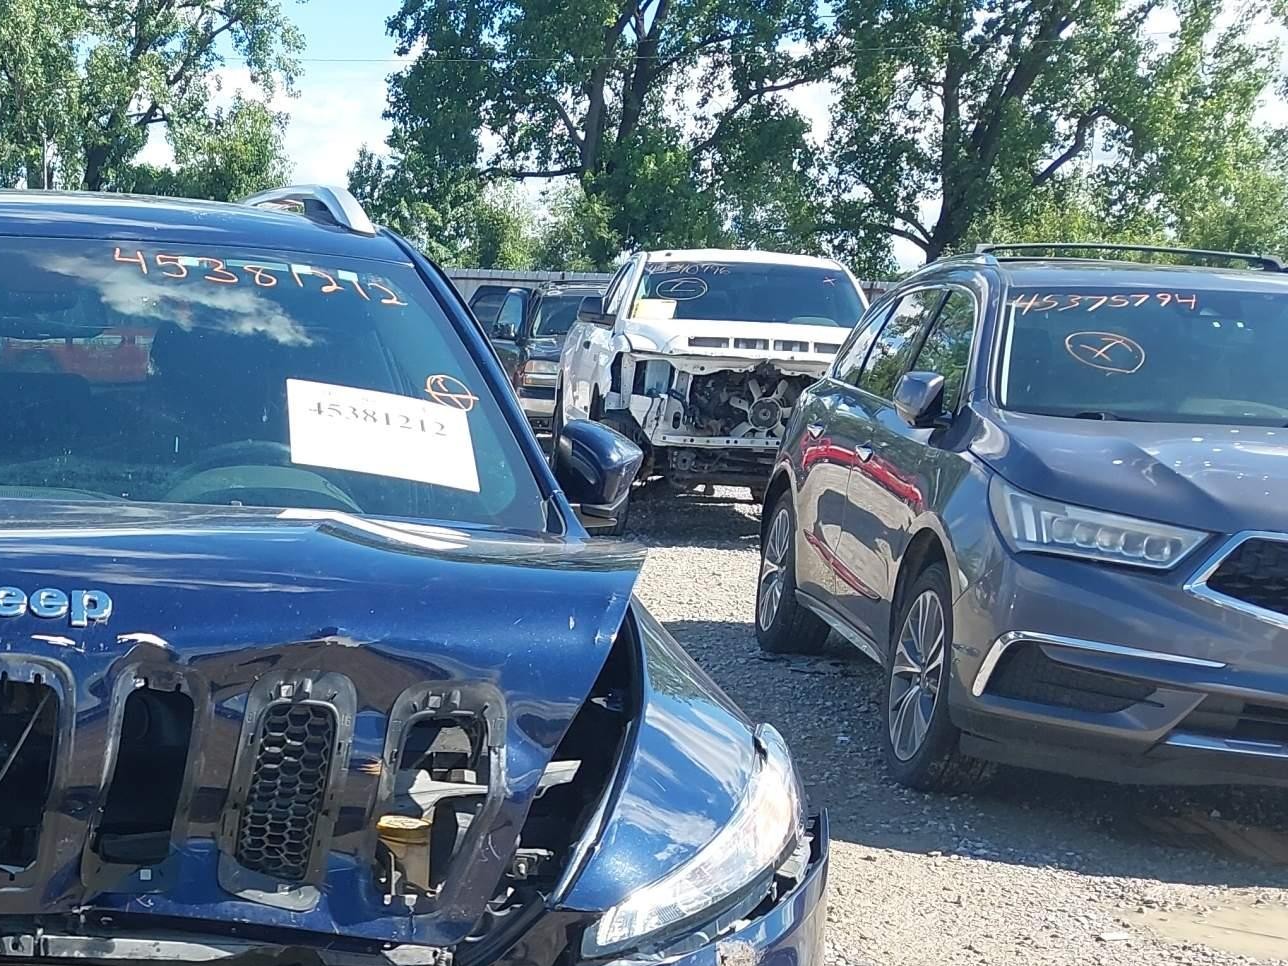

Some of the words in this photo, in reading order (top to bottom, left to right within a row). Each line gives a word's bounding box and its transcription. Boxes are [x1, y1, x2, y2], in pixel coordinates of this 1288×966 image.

[113, 247, 409, 306] 45381212
[1009, 293, 1197, 316] 45375794
[308, 402, 448, 437] 45381212
